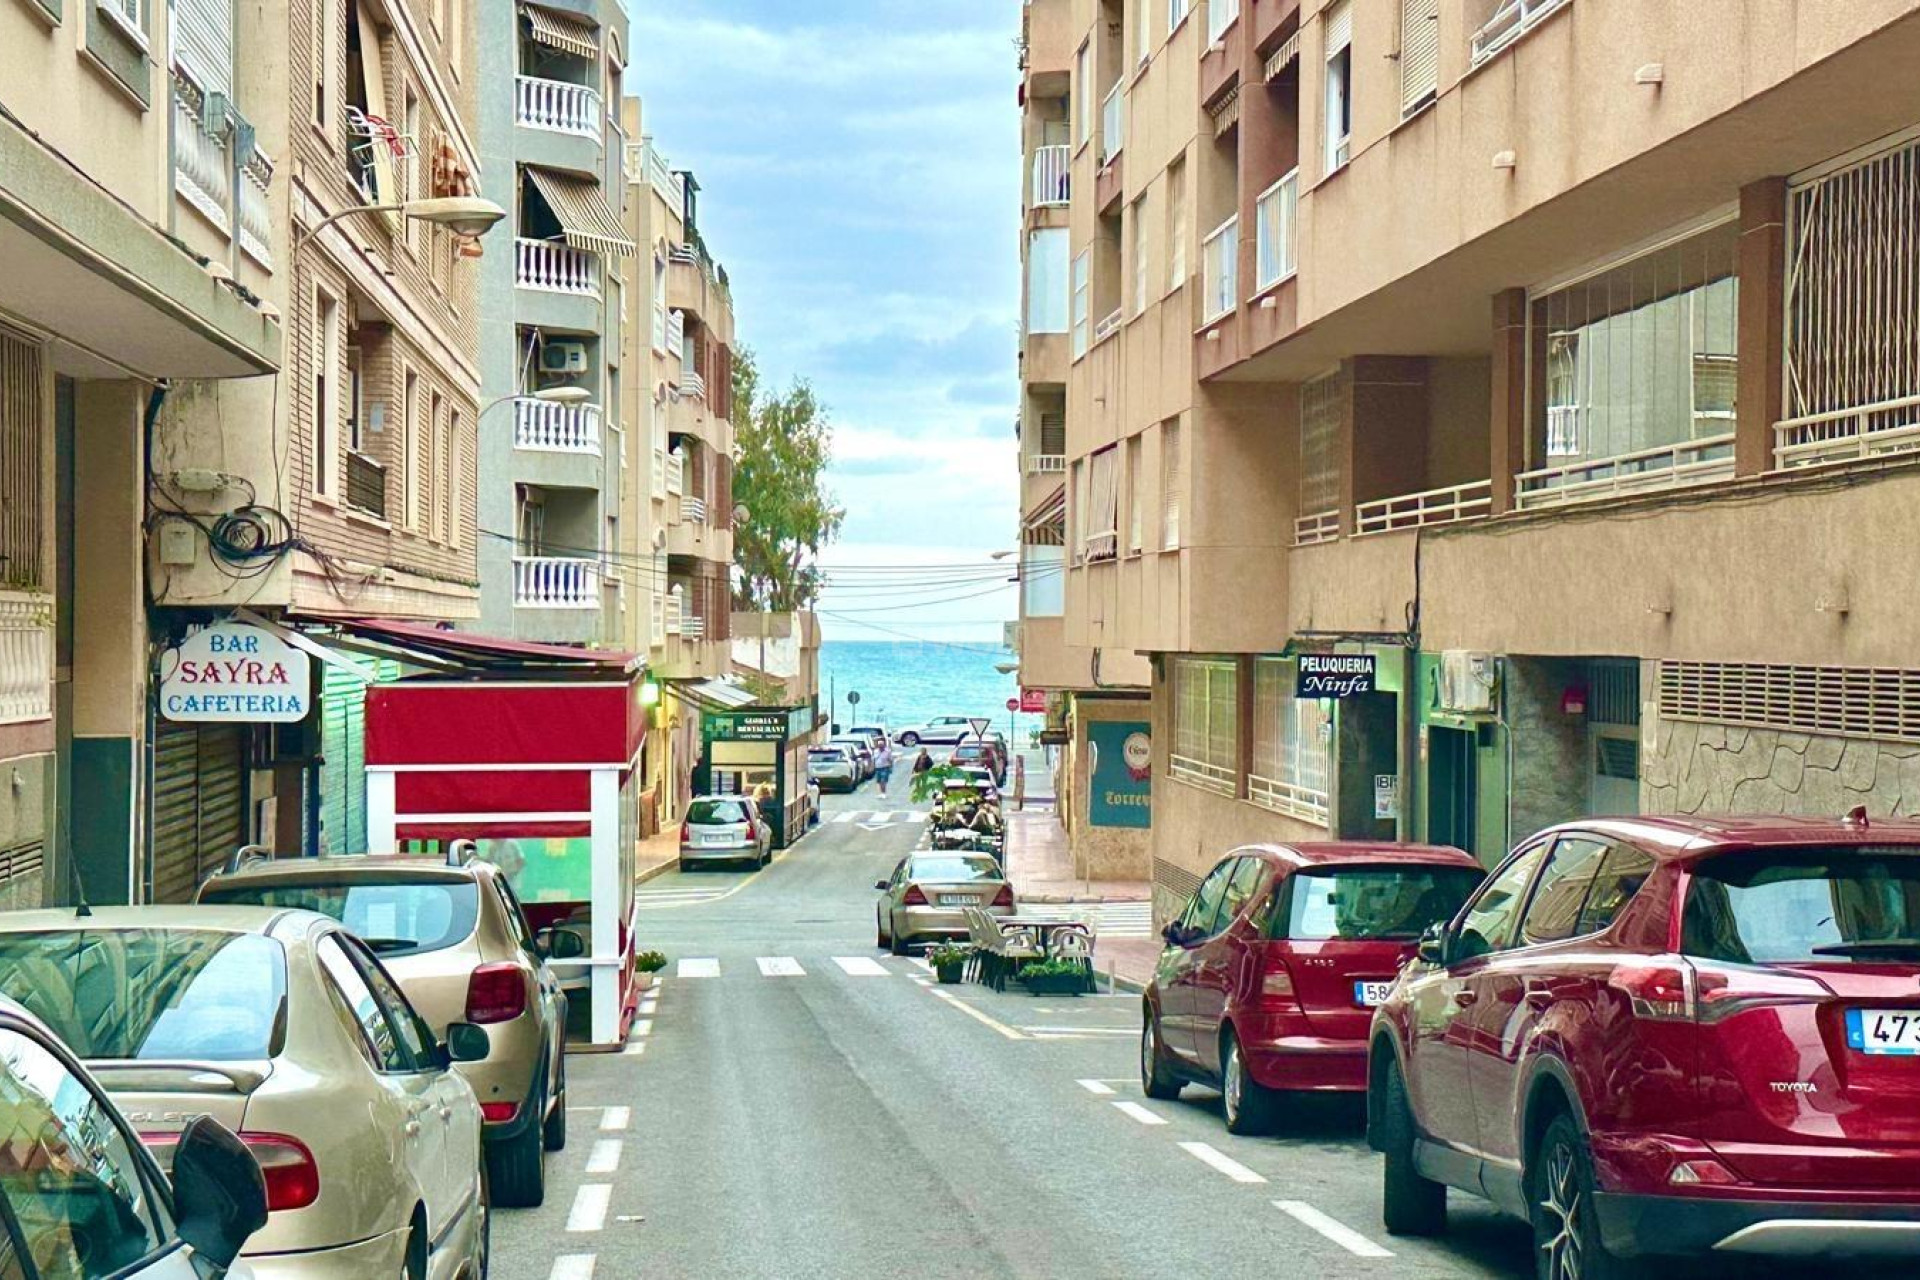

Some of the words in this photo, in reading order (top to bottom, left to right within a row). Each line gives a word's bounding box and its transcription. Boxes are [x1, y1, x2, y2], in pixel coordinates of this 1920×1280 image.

[210, 635, 258, 653] BAR
[180, 657, 289, 684] SAYRA
[1301, 656, 1374, 673] PELUQUERIA
[1303, 675, 1369, 697] Ninfa
[167, 695, 303, 713] CAFETERIA
[1770, 1082, 1817, 1092] TOYOTA
